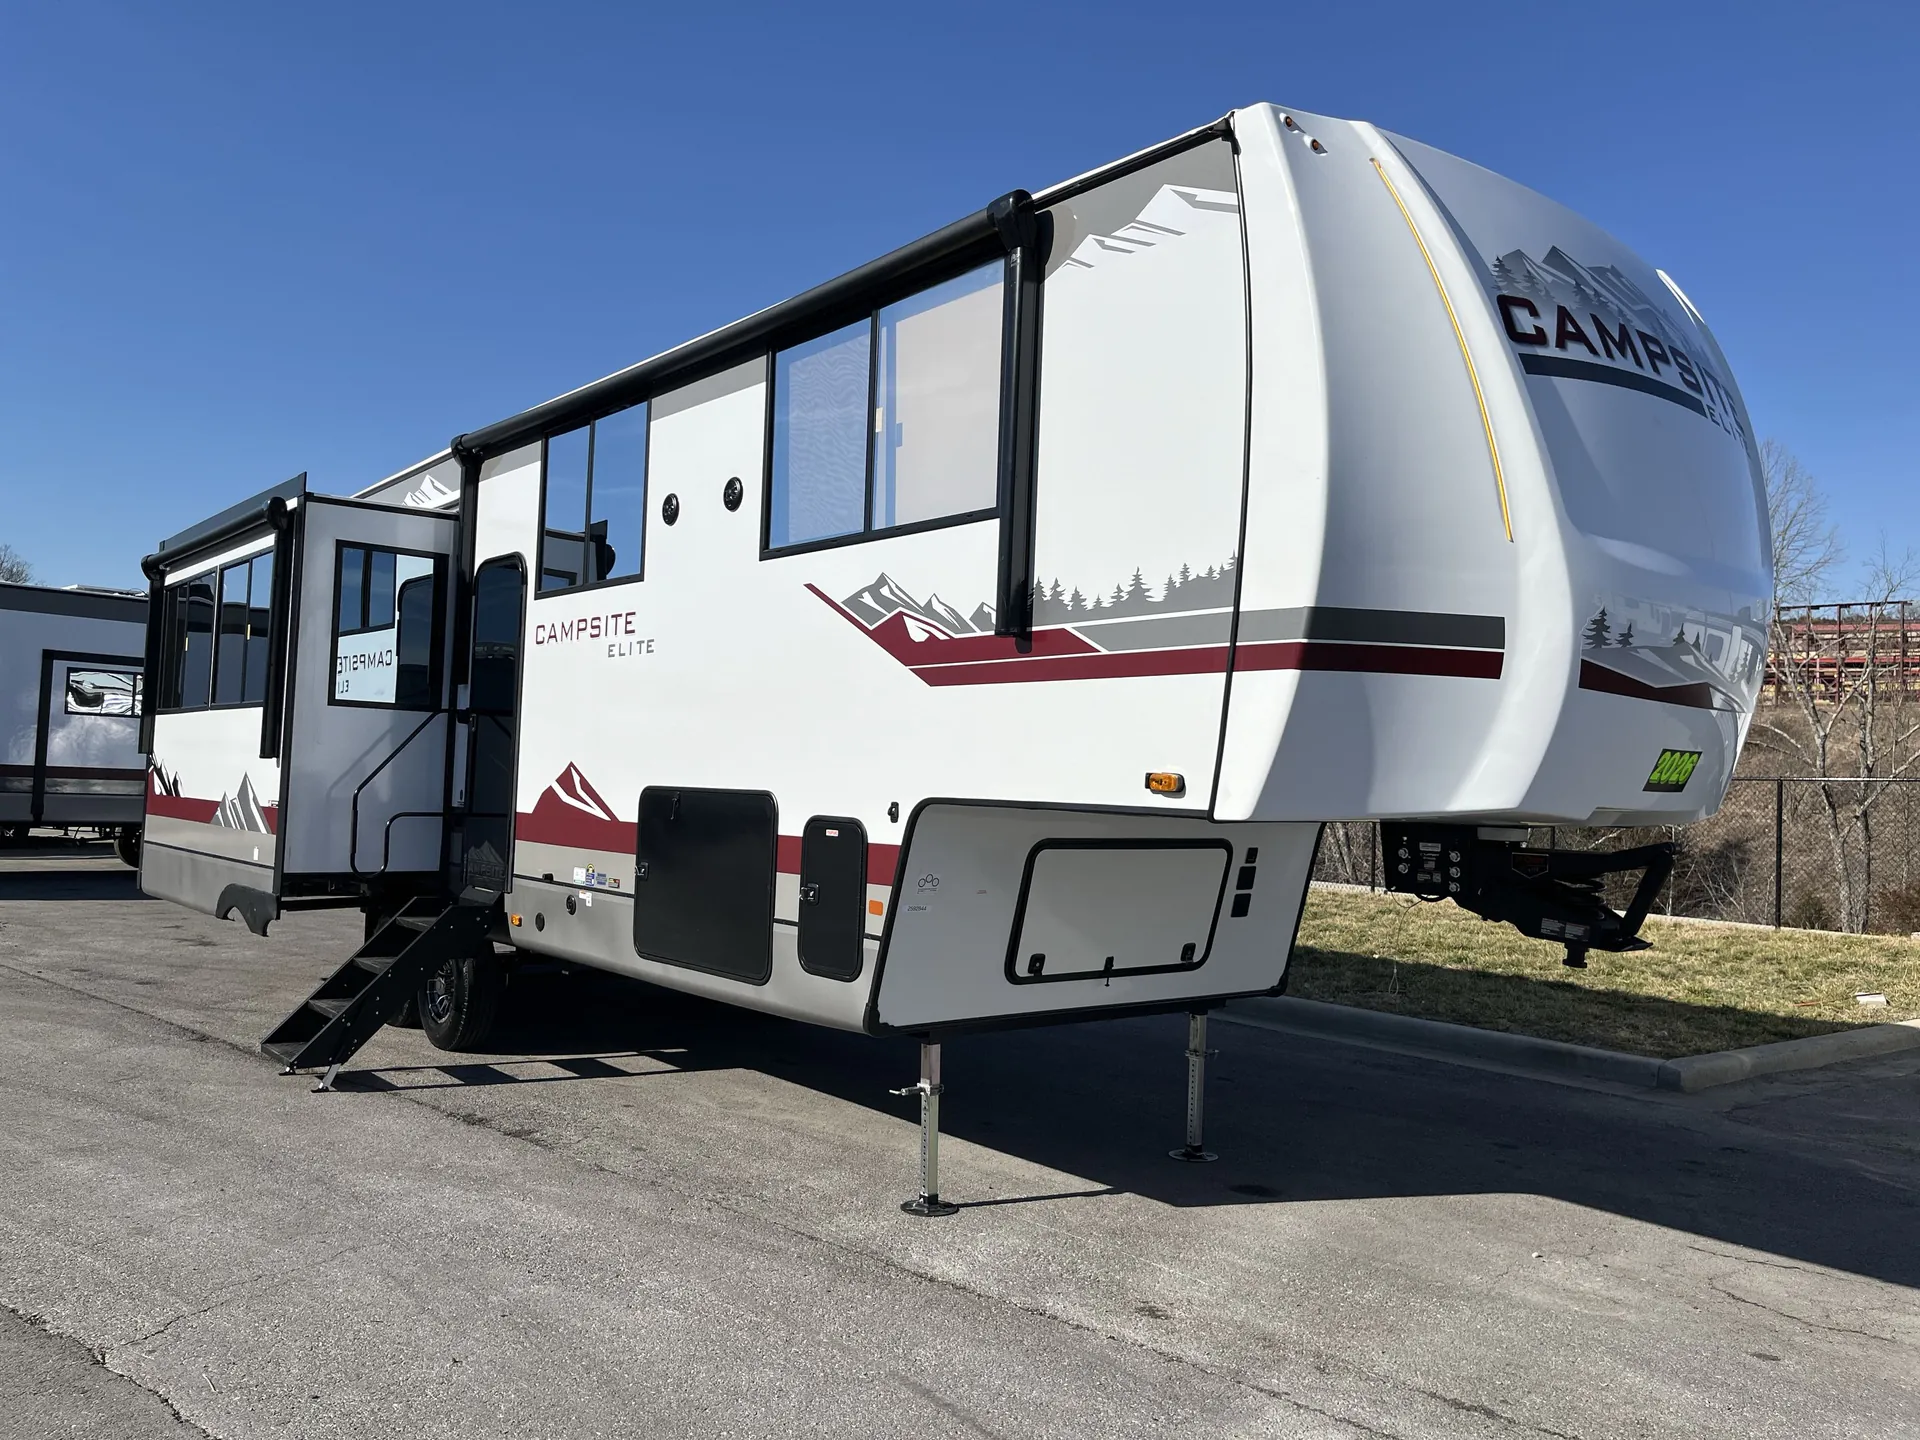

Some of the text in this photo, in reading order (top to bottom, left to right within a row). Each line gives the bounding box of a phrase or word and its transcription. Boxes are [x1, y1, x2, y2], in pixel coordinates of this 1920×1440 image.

[1497, 294, 1745, 437] CAMPSITE
[536, 611, 636, 645] CAMPSITE
[608, 639, 654, 658] ELITE
[1648, 751, 1699, 785] 2026
